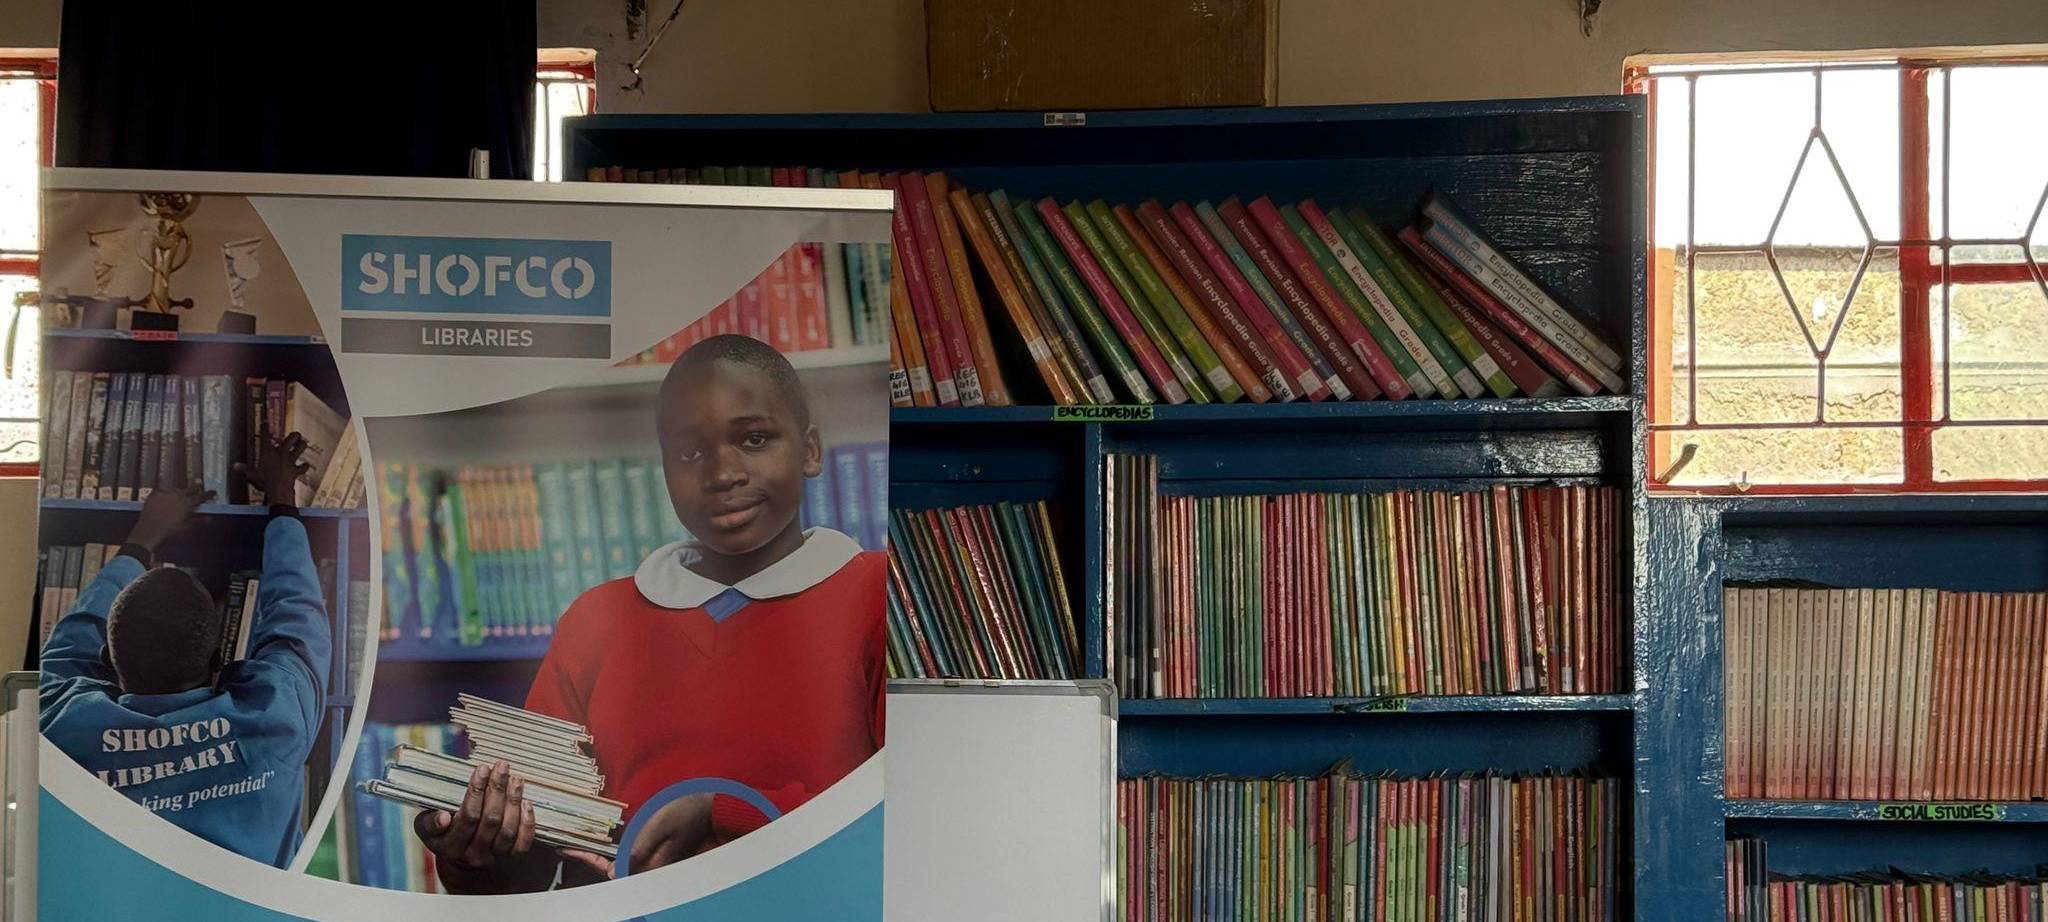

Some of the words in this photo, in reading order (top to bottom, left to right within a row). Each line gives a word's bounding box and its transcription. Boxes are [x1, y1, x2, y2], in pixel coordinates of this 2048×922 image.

[358, 252, 596, 300] SHOFCO
[1157, 218, 1180, 249] Premier
[1178, 248, 1204, 280] Revision
[1201, 279, 1250, 341] Encyclopedia
[1248, 340, 1269, 366] Grade
[1238, 218, 1261, 249] Premier
[1259, 248, 1283, 280] Revision
[1282, 278, 1329, 341] Encyclopedia
[1327, 341, 1348, 367] Grade
[1488, 254, 1545, 305] Encyclopedia
[1551, 309, 1580, 334] Grade
[1350, 264, 1396, 323] Encyclopedia
[1398, 328, 1423, 358] Grade
[1440, 288, 1491, 341] Encyclopedia
[1490, 339, 1512, 361] Grade
[1490, 278, 1547, 328] Encyclopedia
[1555, 333, 1583, 358] Grade
[421, 327, 533, 347] LIBRARIES
[1293, 330, 1314, 358] Grade
[1057, 406, 1150, 419] ENCYCLOPEDIAS
[102, 717, 231, 753] SHOFCO
[96, 741, 236, 788] LIBRARY
[1883, 806, 1933, 819] SOCIAL
[1935, 804, 1995, 819] STUDIES
